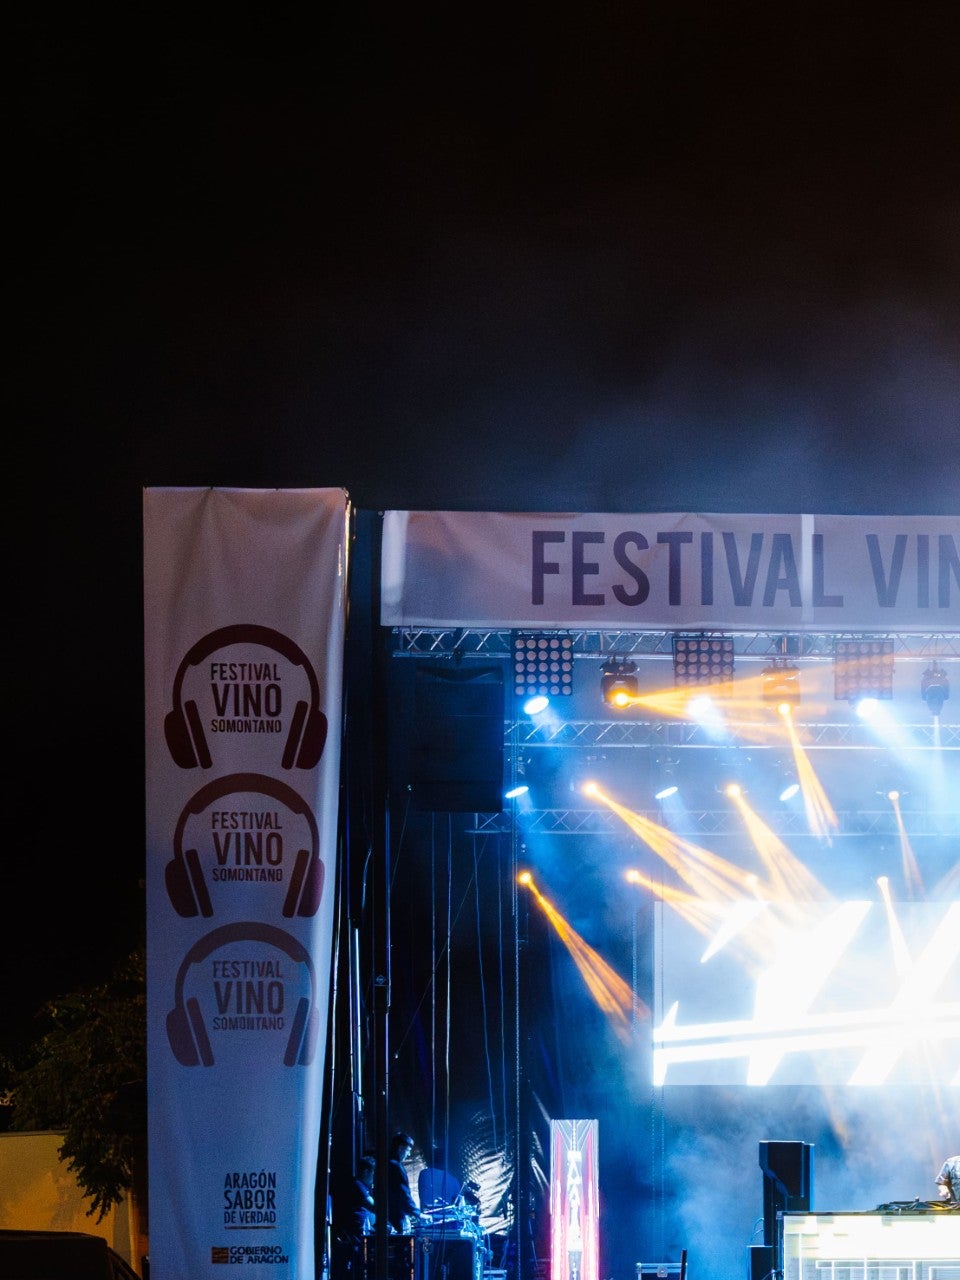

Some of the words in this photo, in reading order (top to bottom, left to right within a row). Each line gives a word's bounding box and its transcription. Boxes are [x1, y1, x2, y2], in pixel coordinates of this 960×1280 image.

[530, 529, 845, 609] FESTIVAL
[210, 662, 282, 682] FESTIVAL
[211, 683, 282, 718] VINO
[210, 719, 283, 734] SOMONTANO
[211, 811, 283, 830] FESTIVAL
[212, 831, 284, 867] VINO
[212, 867, 283, 883] SOMONTANO
[212, 960, 284, 979] FESTIVAL
[213, 980, 285, 1015] VINO
[212, 1016, 285, 1031] SOMONTANO
[223, 1168, 277, 1189] ARAGÓN
[223, 1189, 276, 1210] SABOR
[224, 1211, 237, 1224] DE
[239, 1210, 277, 1224] VERDAD
[229, 1245, 282, 1256] GOBIERNO
[229, 1255, 244, 1264] DE
